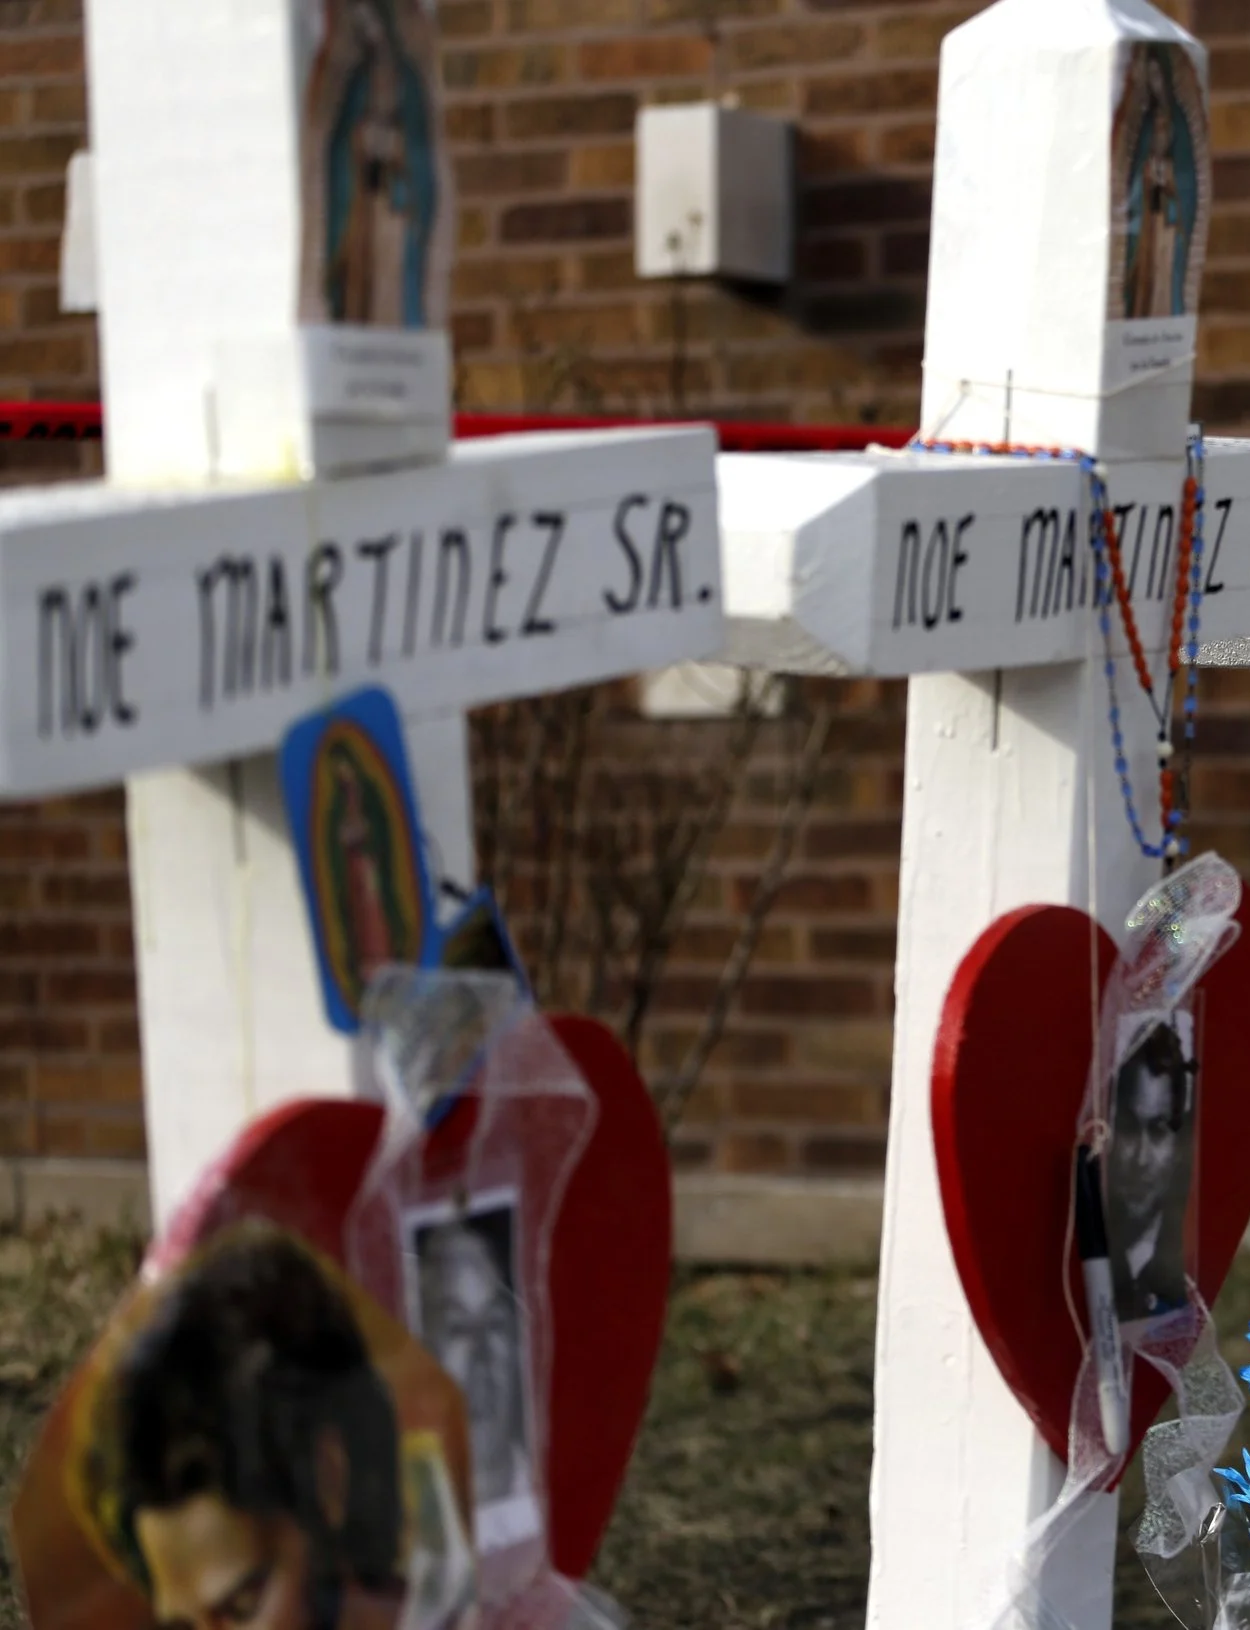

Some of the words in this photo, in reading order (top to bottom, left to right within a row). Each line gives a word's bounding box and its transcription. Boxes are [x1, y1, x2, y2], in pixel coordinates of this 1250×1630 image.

[38, 567, 138, 741] NOE
[198, 510, 566, 710] MARTINEZ
[603, 494, 713, 613] SR.
[892, 511, 976, 631] NOE
[1015, 498, 1232, 622] MATINZ
